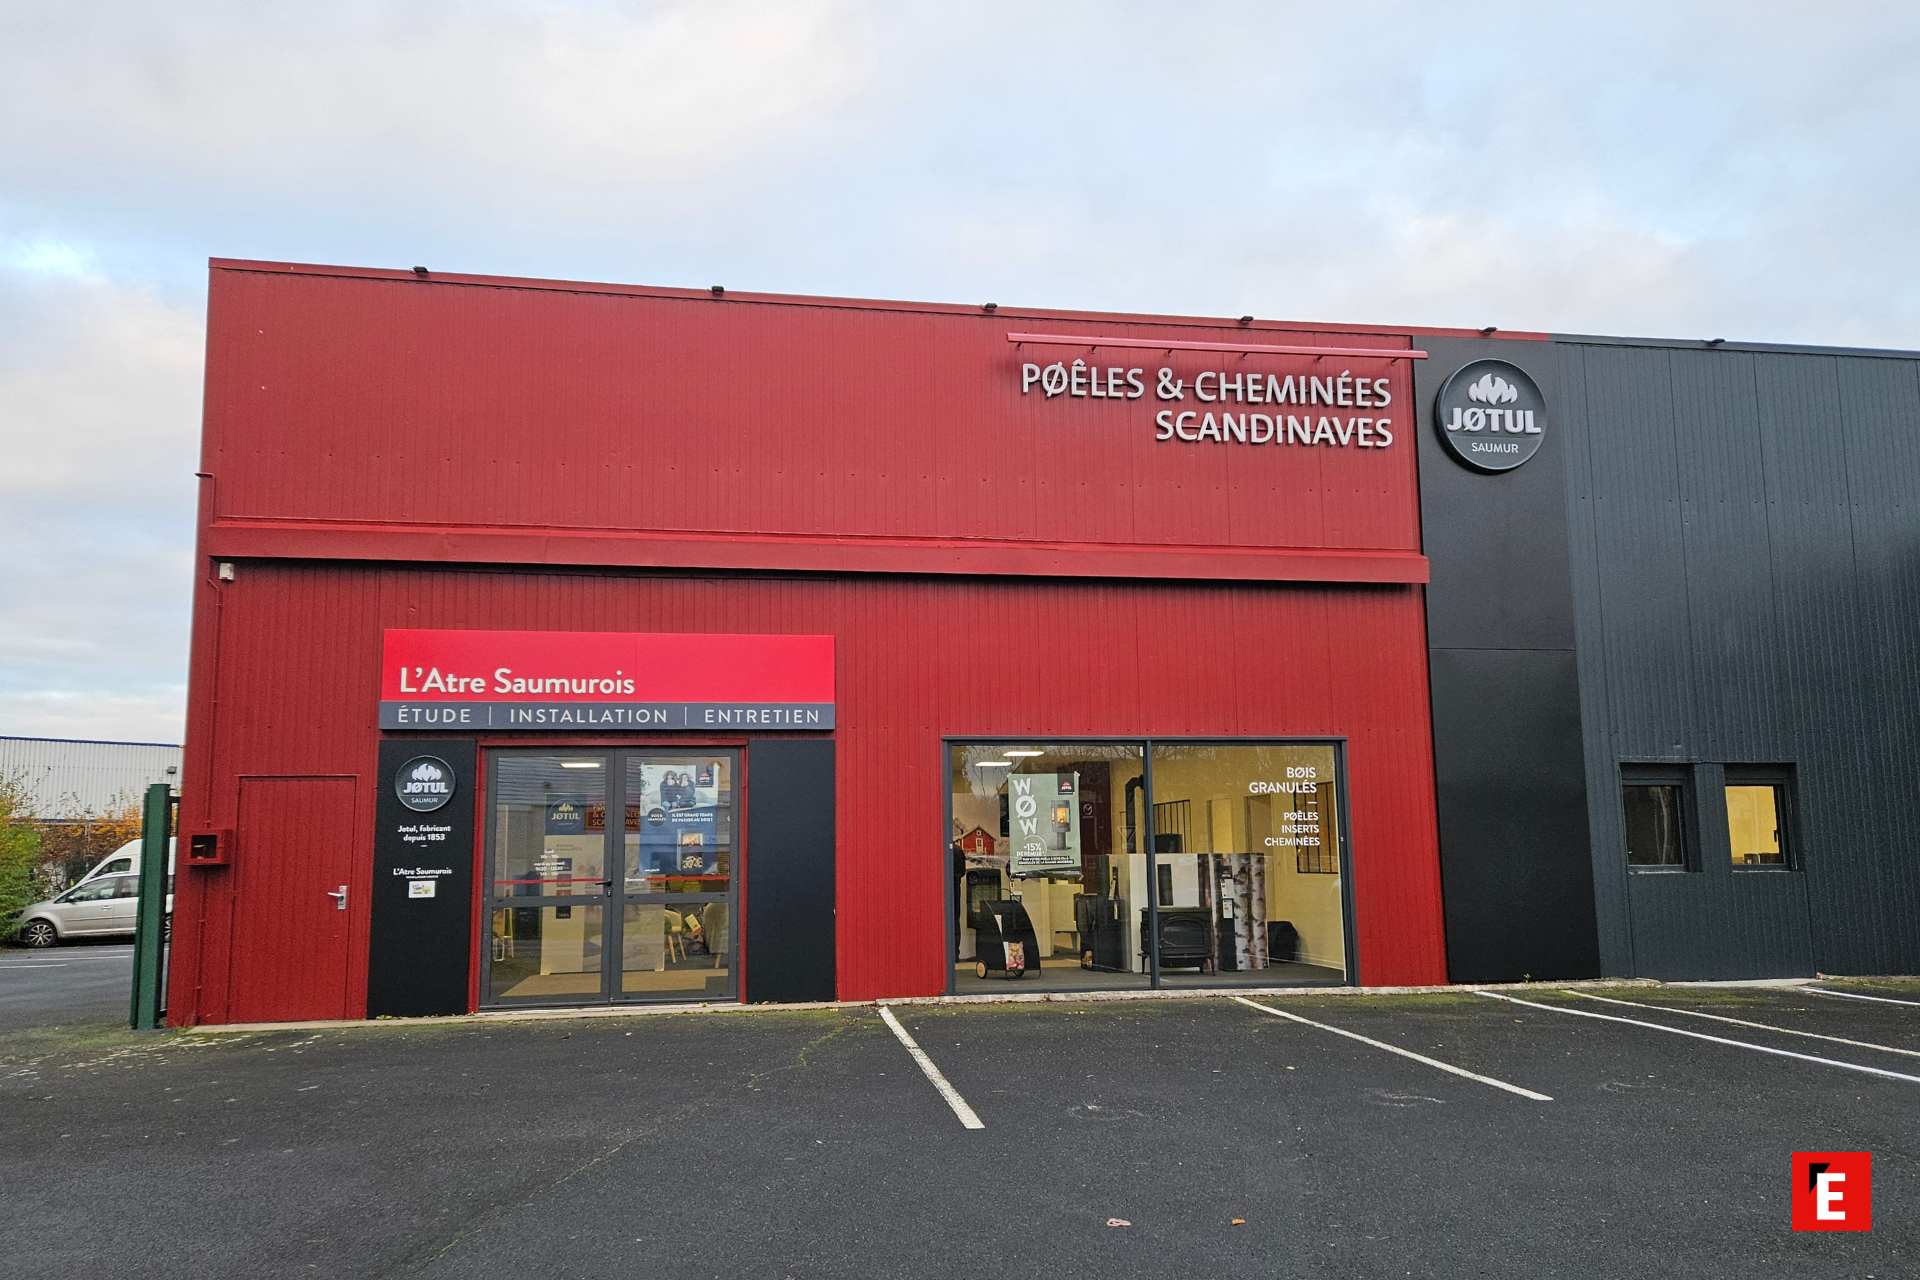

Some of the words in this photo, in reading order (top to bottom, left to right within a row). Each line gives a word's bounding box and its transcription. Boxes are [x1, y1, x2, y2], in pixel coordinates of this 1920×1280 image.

[1022, 358, 1145, 398] PØÊLES
[1156, 367, 1185, 400] &
[1195, 369, 1392, 408] CHEMINÉES
[1446, 407, 1542, 434] JØTUL
[1156, 410, 1393, 448] SCANDINAVES
[1471, 442, 1519, 454] SAUMUR
[494, 667, 635, 694] Saumurois
[398, 705, 471, 723] ÉTUDE
[510, 709, 667, 723] INSTALLATION
[704, 709, 819, 723] ENTRETIEN
[1286, 767, 1316, 778] BØIS
[403, 782, 448, 793] JØTUL
[1249, 779, 1318, 794] GRANULÉS
[551, 812, 580, 820] JØTUL
[1283, 809, 1319, 821] PØÊLES
[420, 824, 452, 832] fabricant
[1281, 823, 1320, 834] INSERTS
[403, 834, 426, 843] depuis
[427, 833, 446, 841] 1853
[1264, 835, 1321, 847] CHEMINÉES
[415, 866, 453, 875] Saumurois
